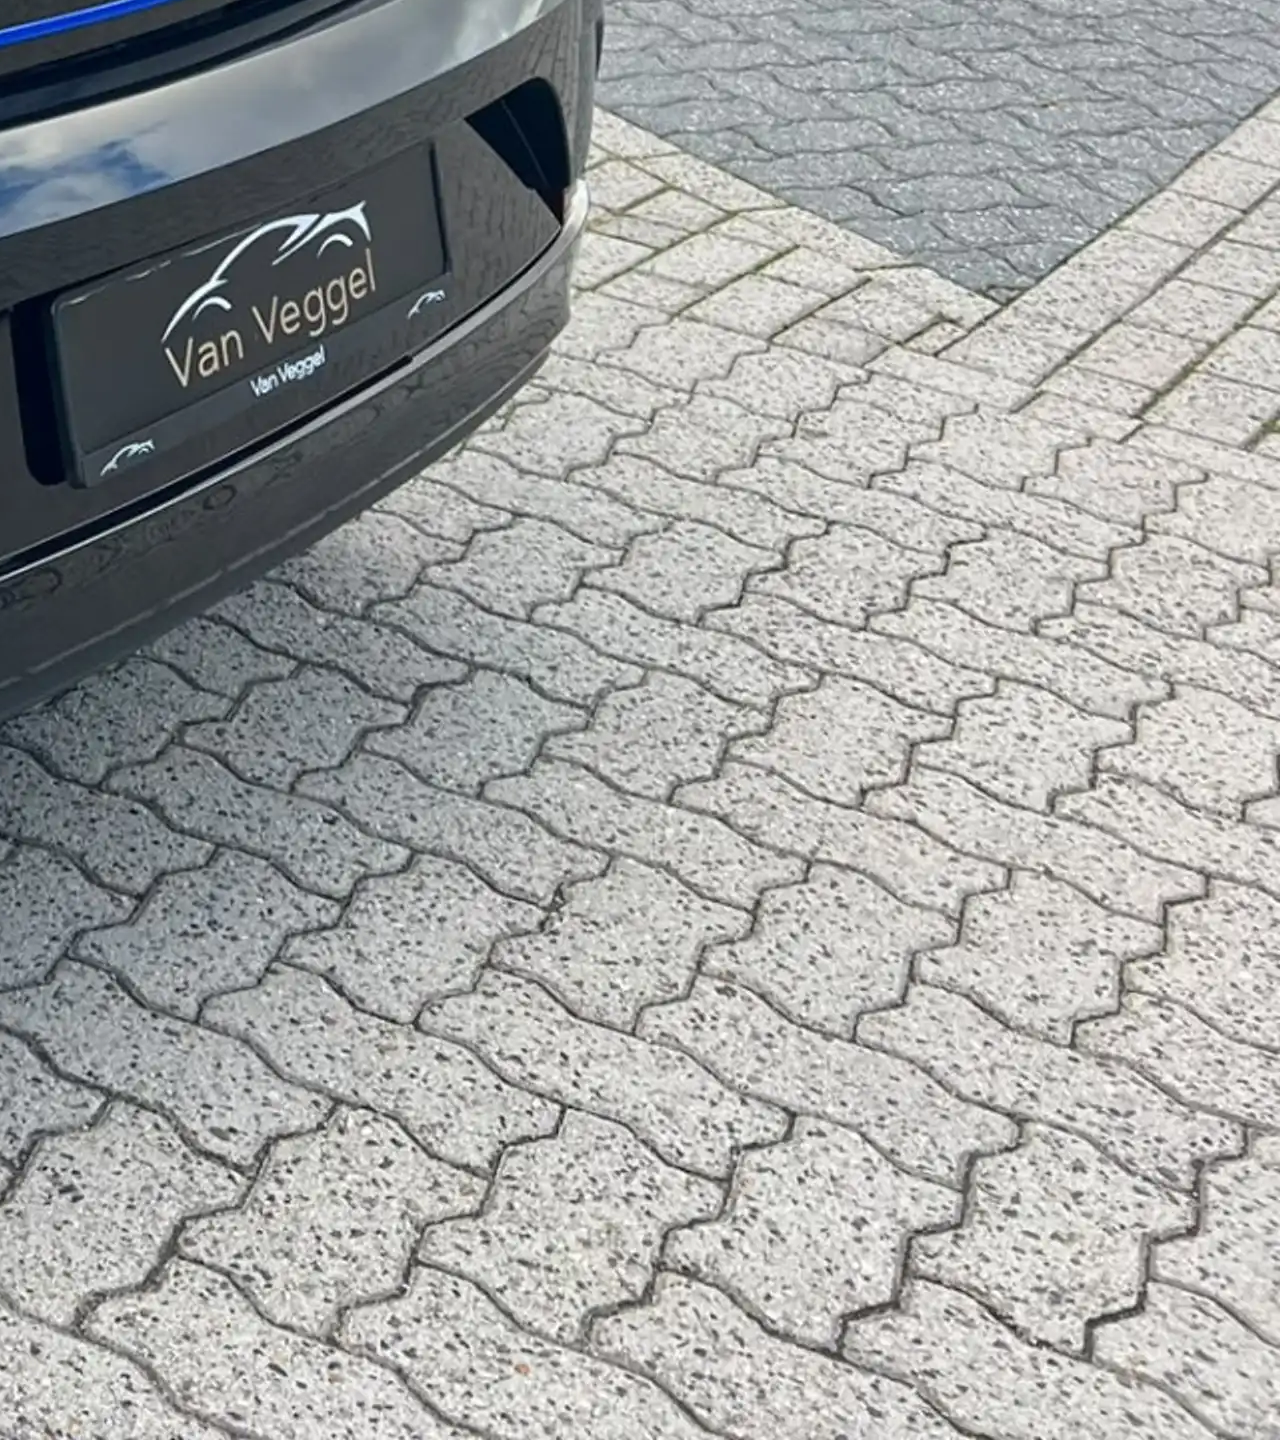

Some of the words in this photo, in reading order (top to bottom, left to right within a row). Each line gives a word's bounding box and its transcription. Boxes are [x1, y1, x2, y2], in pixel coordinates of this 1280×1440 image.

[164, 328, 244, 389] Van
[251, 246, 377, 345] Veggel
[249, 370, 279, 397] Van
[277, 343, 327, 382] Veggel
